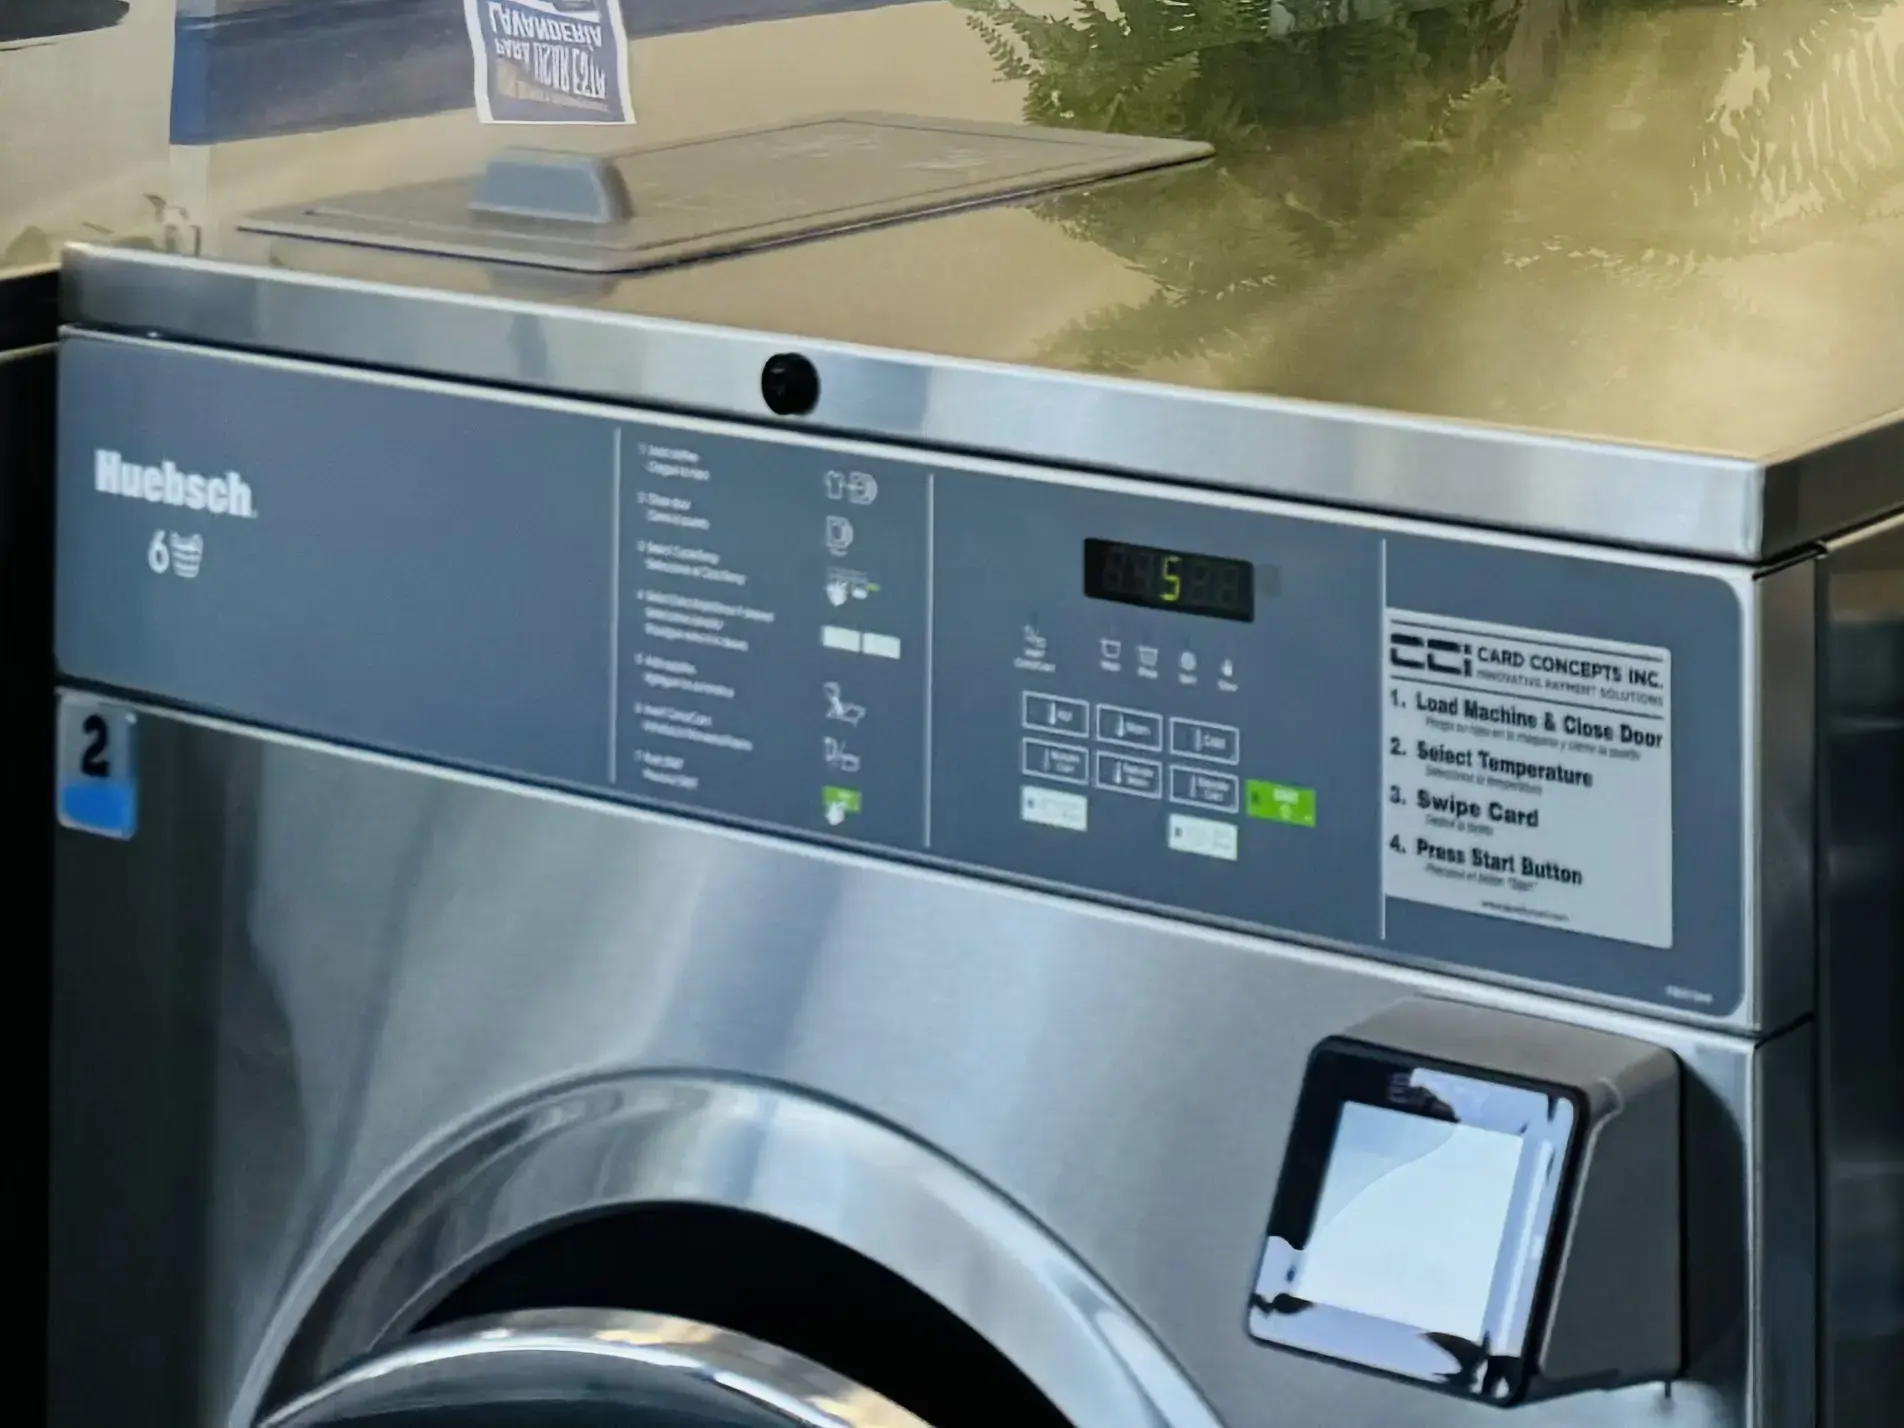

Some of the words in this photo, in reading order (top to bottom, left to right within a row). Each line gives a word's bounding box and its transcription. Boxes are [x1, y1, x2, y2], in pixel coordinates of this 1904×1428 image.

[94, 449, 254, 518] Huebsch
[147, 530, 170, 574] 6
[1159, 555, 1182, 601] 5
[1476, 647, 1526, 668] CARD
[1530, 654, 1622, 683] CONCEPTS
[1628, 668, 1664, 690] INC.
[1391, 690, 1407, 710] 1.
[1416, 691, 1459, 717] Load
[1464, 699, 1538, 730] Machine
[1543, 712, 1557, 732] &
[1563, 715, 1614, 741] Close
[1620, 723, 1664, 750] Door
[80, 714, 111, 779] 2
[1390, 736, 1407, 756] 2.
[1416, 741, 1473, 768] Select
[1478, 750, 1594, 788] Temperature
[1389, 784, 1407, 806] 3.
[1416, 789, 1481, 820] Swipe
[1487, 801, 1540, 828] Card
[1389, 834, 1407, 855] 4.
[1416, 838, 1466, 864] Press
[1471, 847, 1516, 875] Start
[1521, 856, 1584, 886] Button
